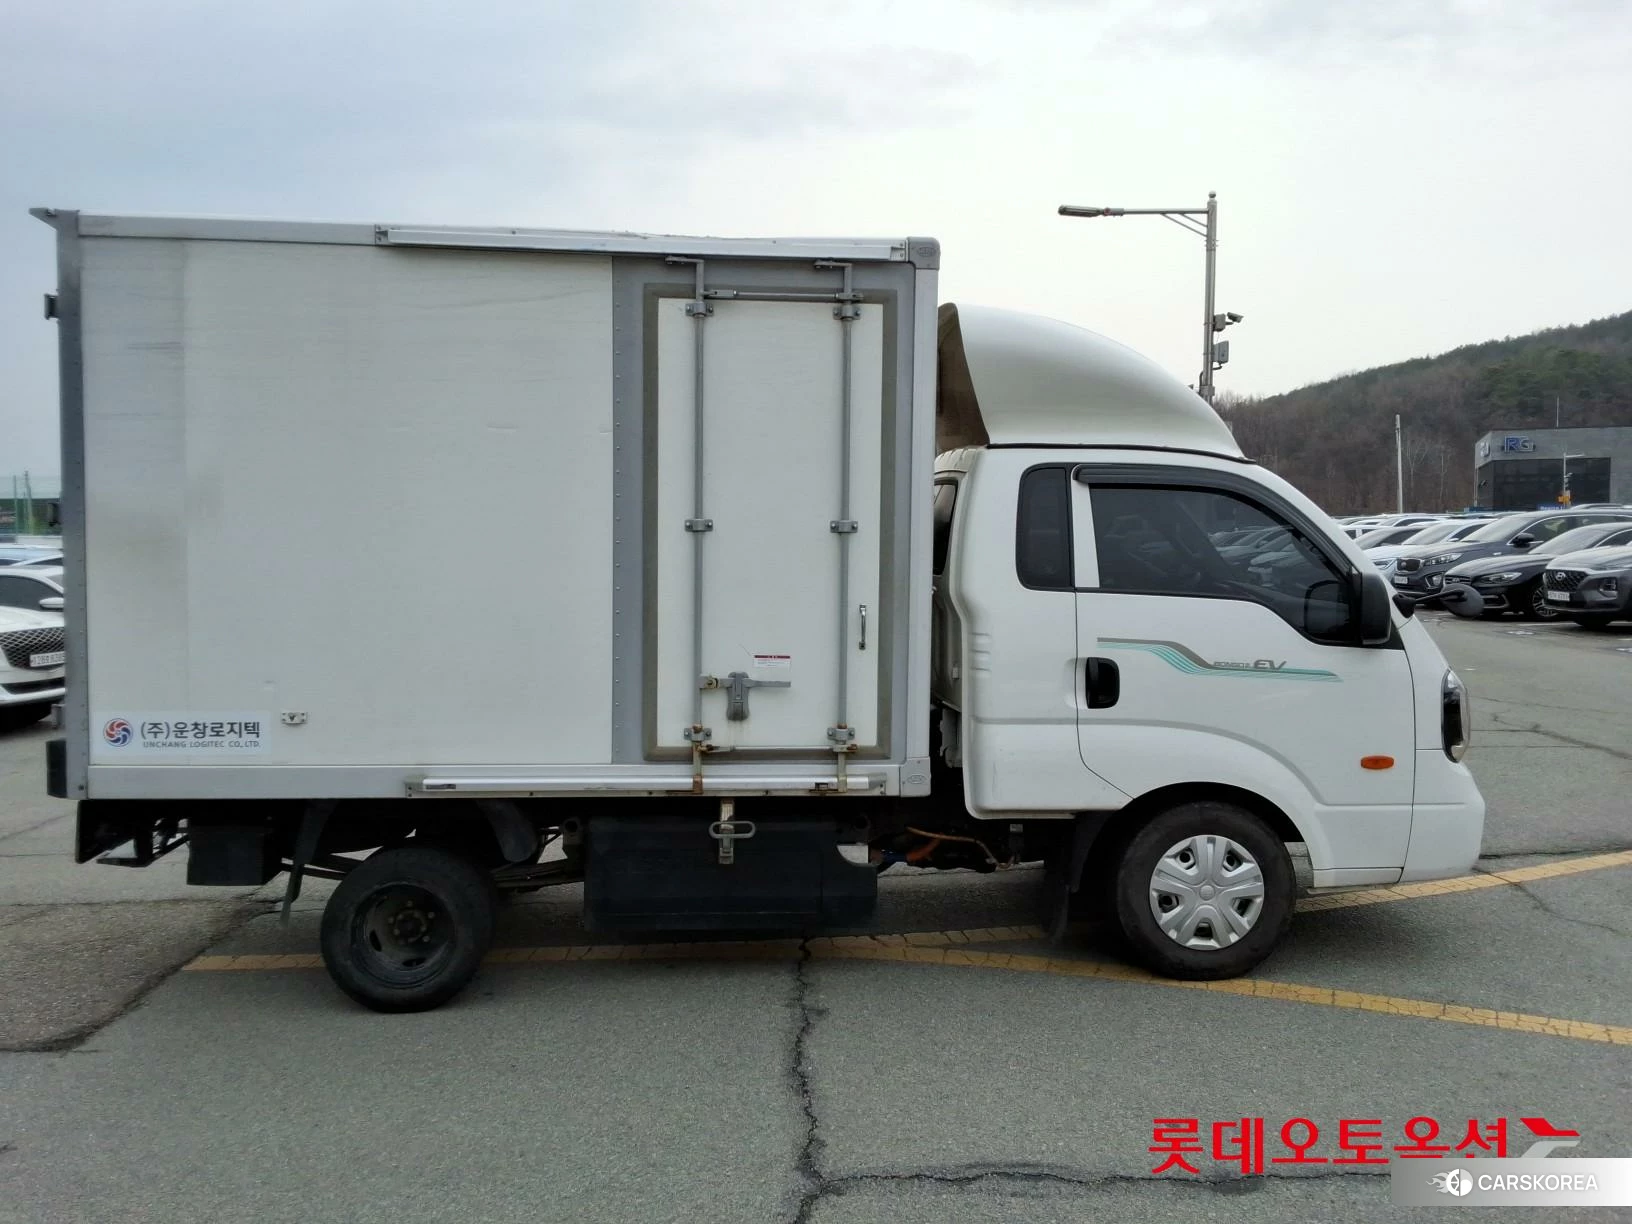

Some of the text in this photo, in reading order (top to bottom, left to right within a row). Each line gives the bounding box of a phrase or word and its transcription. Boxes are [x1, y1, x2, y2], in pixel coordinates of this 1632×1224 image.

[140, 721, 260, 740] (주)운창로지텍
[143, 740, 187, 748] UNCHANG
[189, 740, 225, 748] LOGITEC
